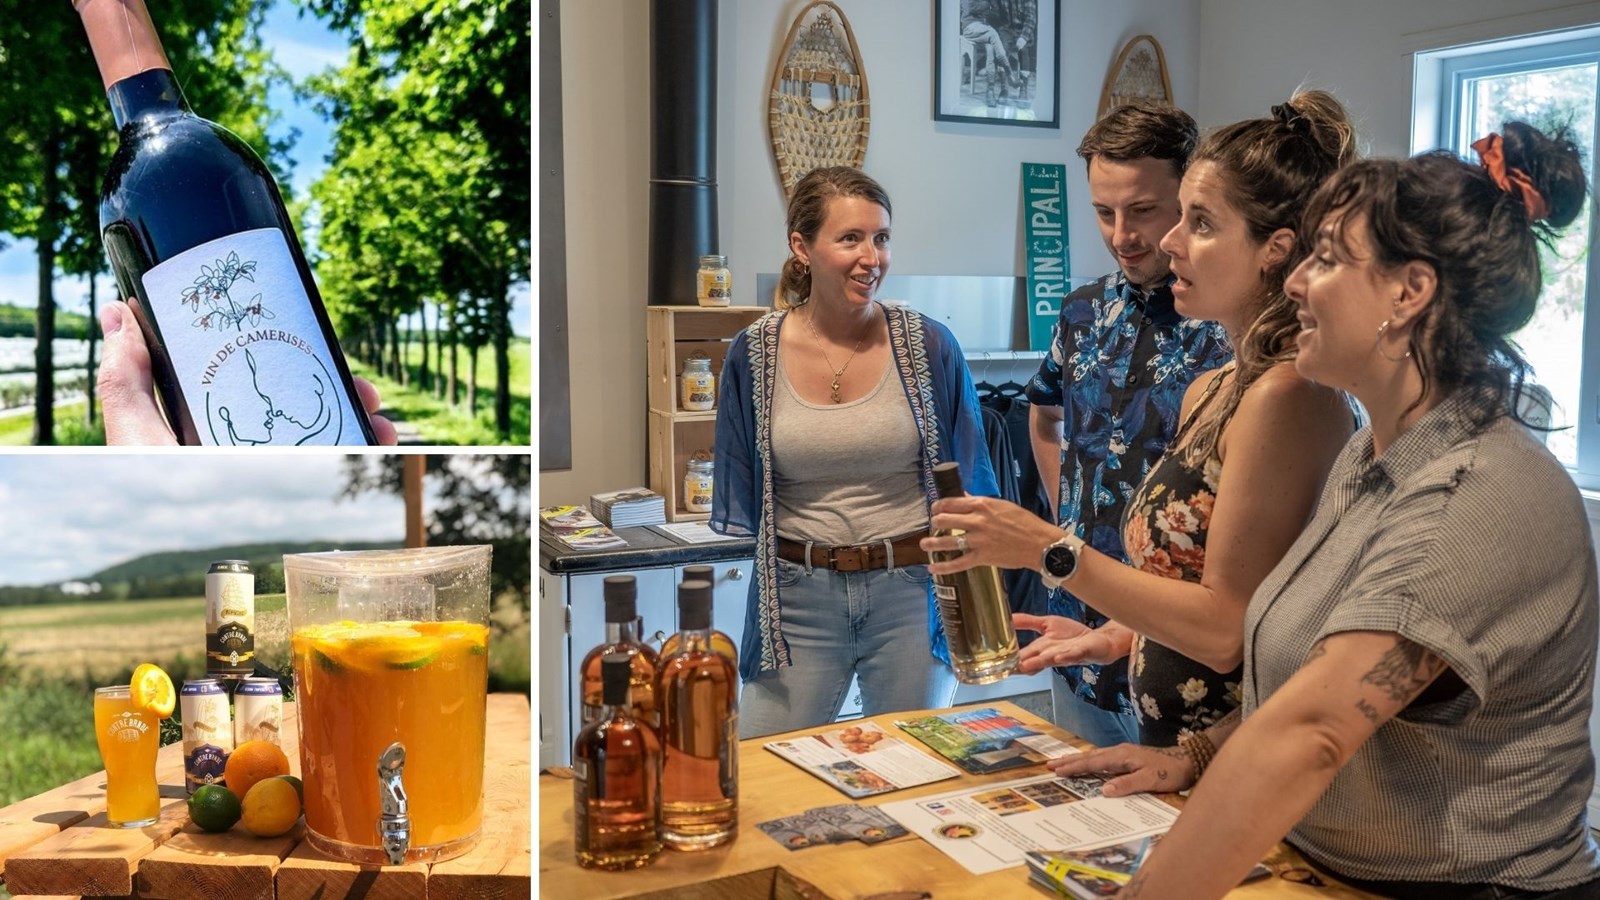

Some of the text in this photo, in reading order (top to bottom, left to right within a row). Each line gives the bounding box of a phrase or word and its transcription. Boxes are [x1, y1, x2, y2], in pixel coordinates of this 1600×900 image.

[1030, 165, 1064, 316] PRINCIPALE
[202, 329, 314, 387] VIN DE CAMERISES
